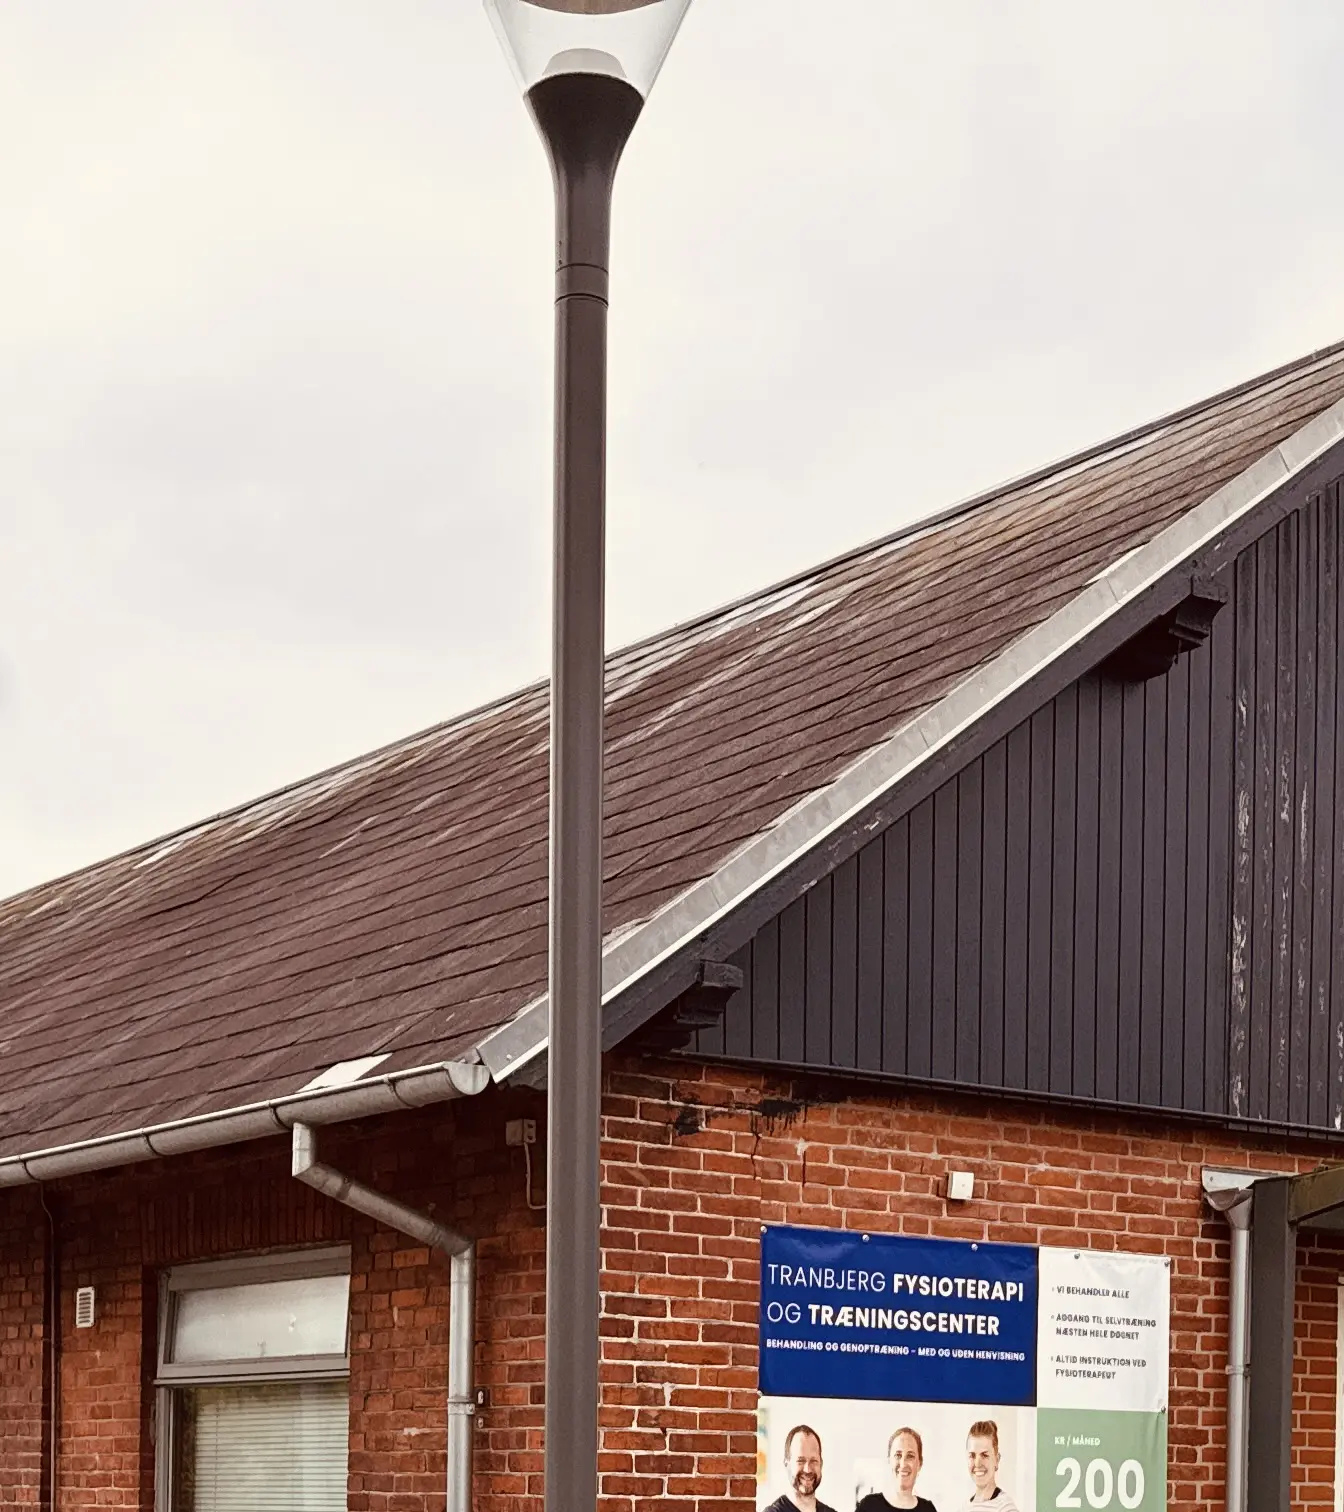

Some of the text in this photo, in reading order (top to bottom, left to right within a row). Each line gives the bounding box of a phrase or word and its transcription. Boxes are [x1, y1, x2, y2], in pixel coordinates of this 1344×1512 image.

[767, 1263, 1024, 1302] TRANBJERG FYSIOTERAPI
[1057, 1285, 1065, 1294] VI
[1112, 1289, 1130, 1299] ALLE
[767, 1301, 1000, 1336] OG TRÆNINGSCENTER
[1092, 1315, 1103, 1325] TIL
[1089, 1329, 1108, 1339] HELE
[766, 1338, 824, 1351] BEHANDLING
[825, 1341, 839, 1352] OG
[840, 1342, 910, 1356] GENOPTRÆNING
[917, 1346, 937, 1357] MED
[938, 1347, 951, 1357] OG
[952, 1348, 974, 1359] UDEN
[975, 1349, 1026, 1362] HENVISNING
[1056, 1354, 1147, 1368] ALTID INSTRUKTION VED
[1054, 1436, 1065, 1446] KR
[1072, 1434, 1101, 1447] MÅNED
[1055, 1456, 1145, 1510] 200
